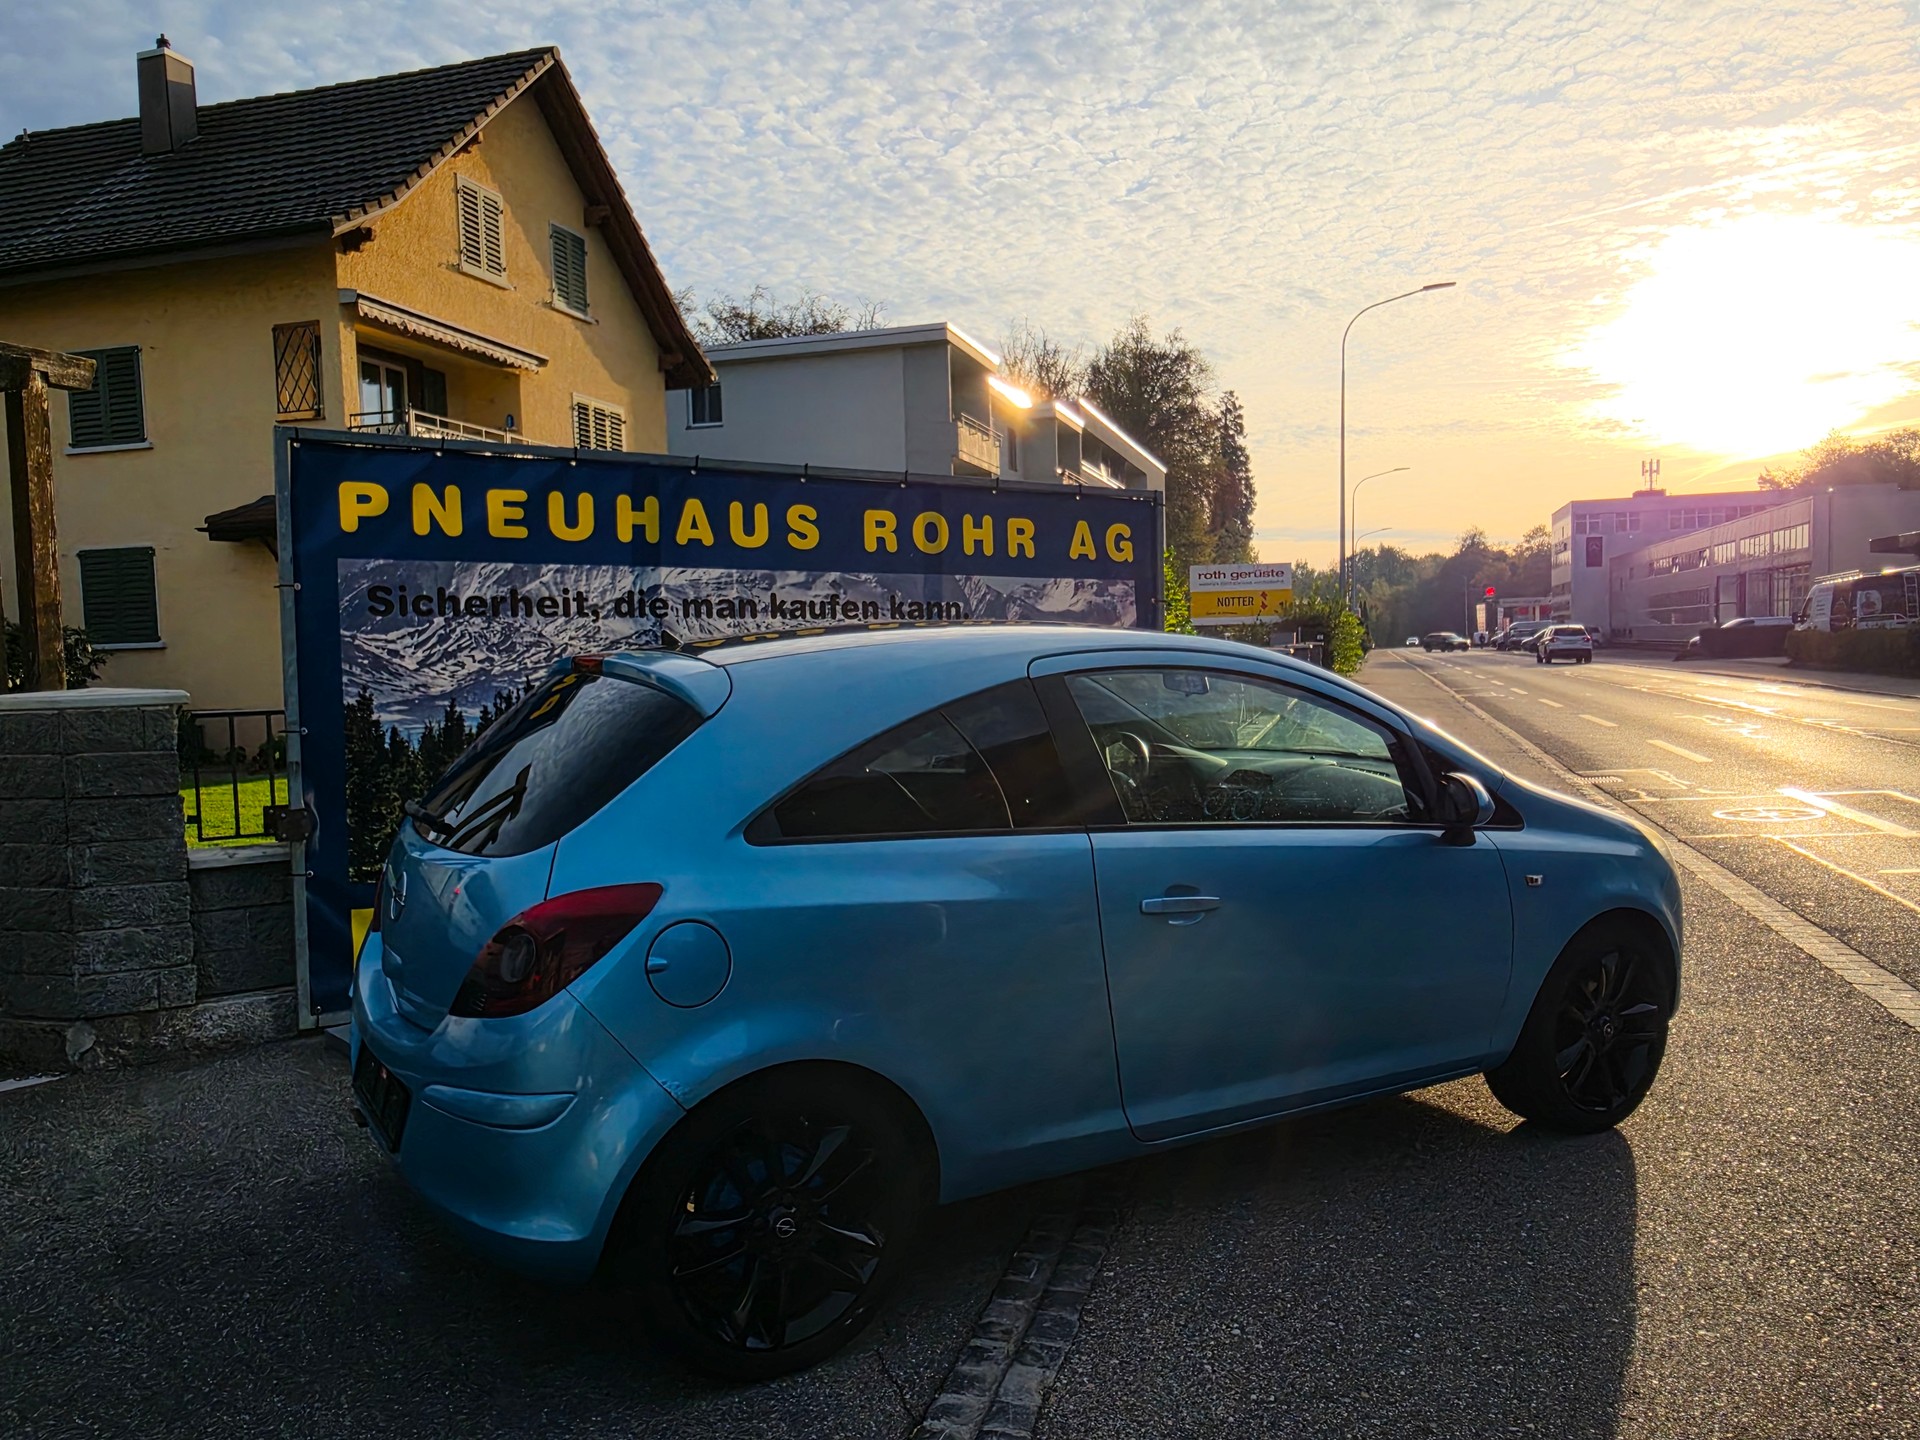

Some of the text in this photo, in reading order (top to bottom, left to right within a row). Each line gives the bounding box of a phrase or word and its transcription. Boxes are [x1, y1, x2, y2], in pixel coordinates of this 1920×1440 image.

[338, 481, 1134, 563] PNEUHAUS ROHR AG
[1198, 569, 1284, 580] roth gerüste
[367, 585, 969, 622] Sicherheit, die man kaufen kann.
[1217, 596, 1254, 607] NOTTER
